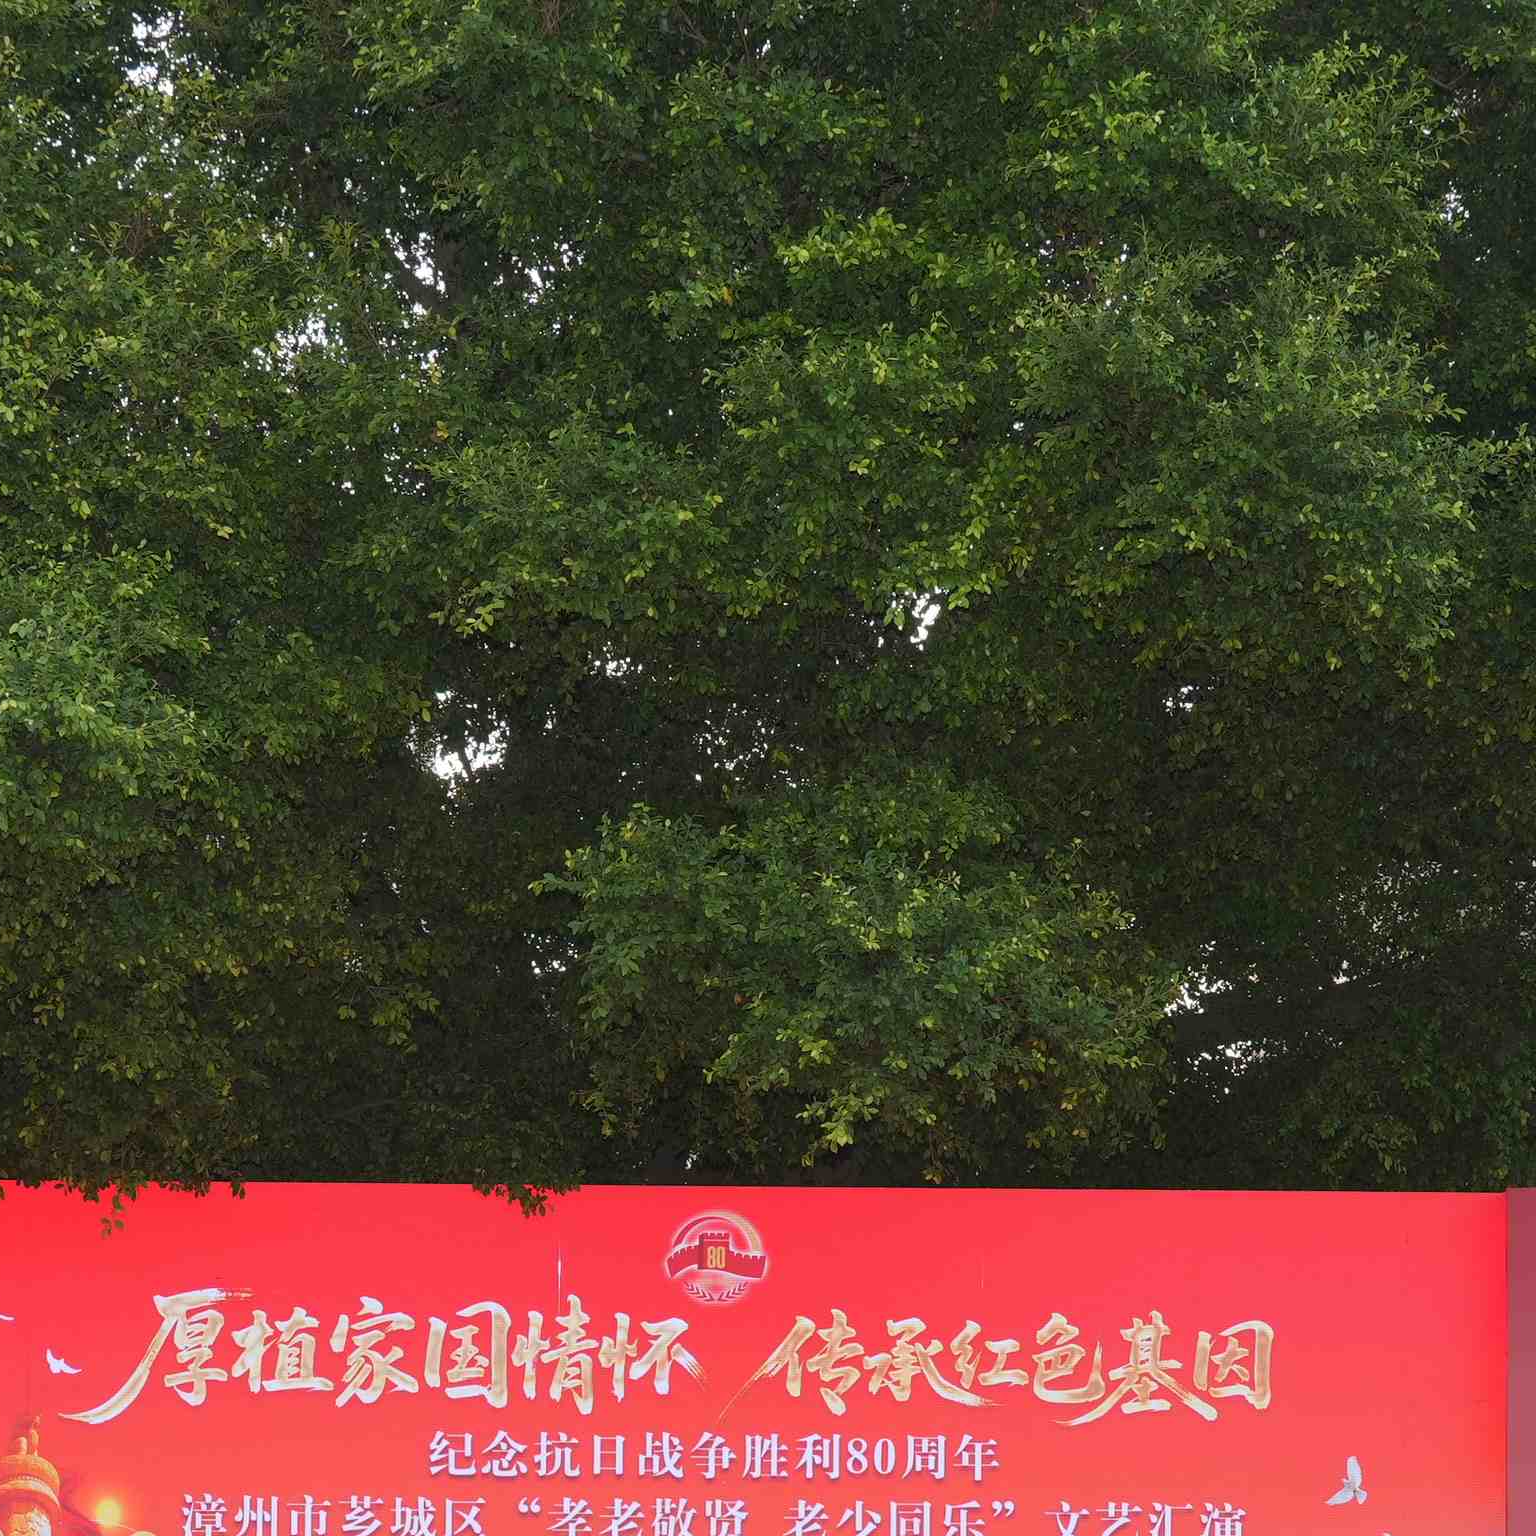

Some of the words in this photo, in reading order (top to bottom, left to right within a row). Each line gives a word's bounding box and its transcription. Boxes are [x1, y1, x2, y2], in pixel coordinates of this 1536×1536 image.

[706, 1245, 727, 1270] 80
[59, 1287, 709, 1424] 厚植家国情怀
[717, 1308, 1275, 1428] 传承红色基因
[429, 1430, 1000, 1482] 纪念抗日战争胜利80周年
